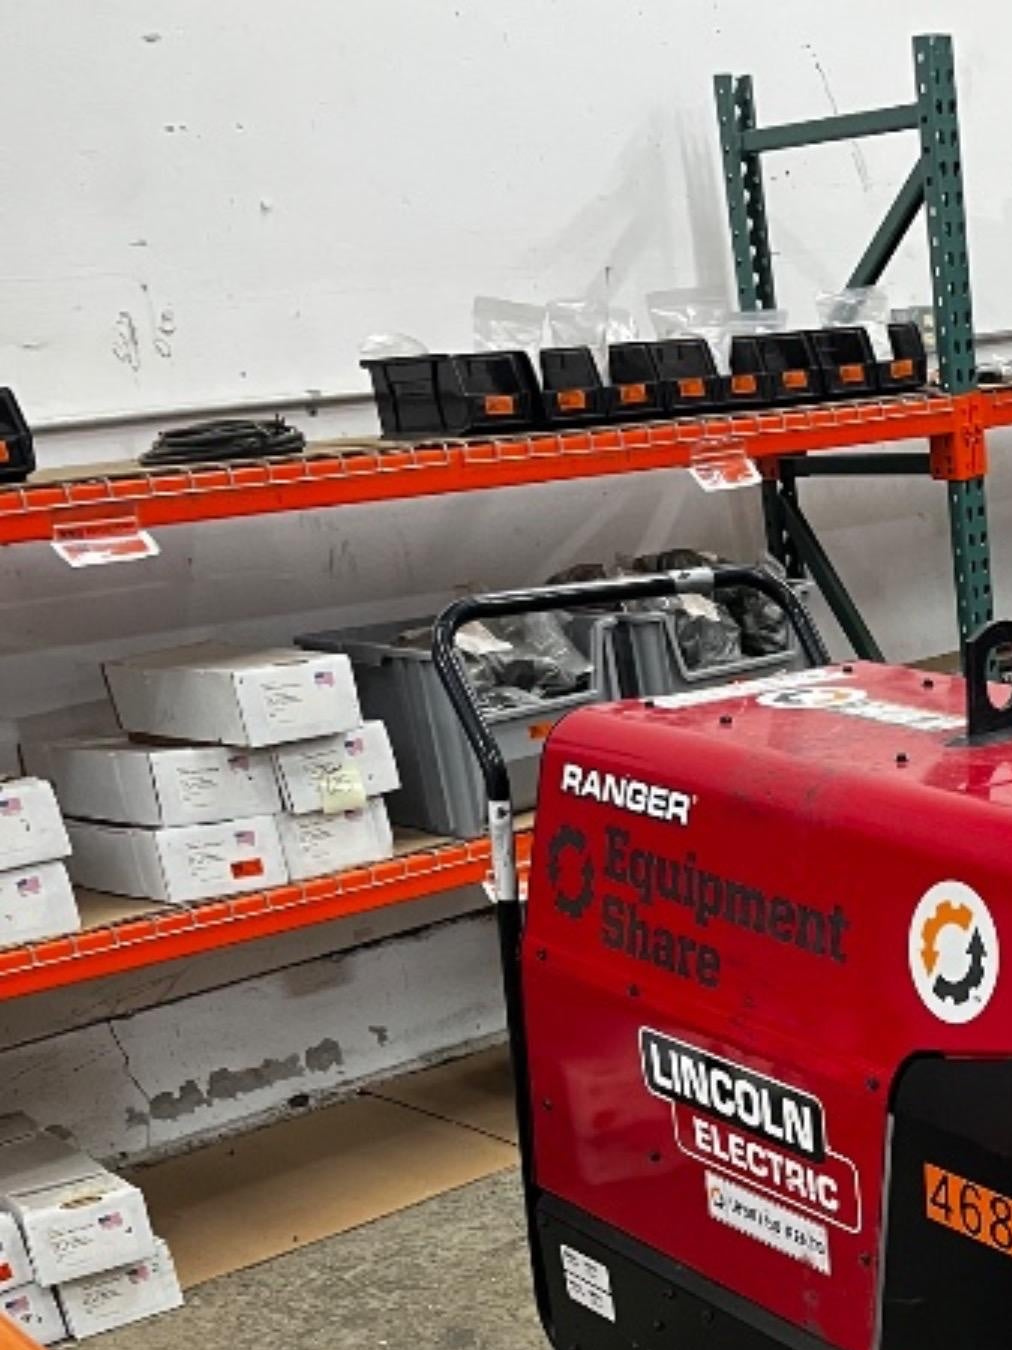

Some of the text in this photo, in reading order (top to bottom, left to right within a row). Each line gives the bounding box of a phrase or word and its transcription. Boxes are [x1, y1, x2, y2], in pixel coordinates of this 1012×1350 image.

[561, 762, 692, 826] RANGER
[601, 894, 721, 988] Share
[603, 826, 850, 965] Equipment
[650, 1040, 815, 1154] LINCOLN
[692, 1115, 841, 1213] ELECTRIC
